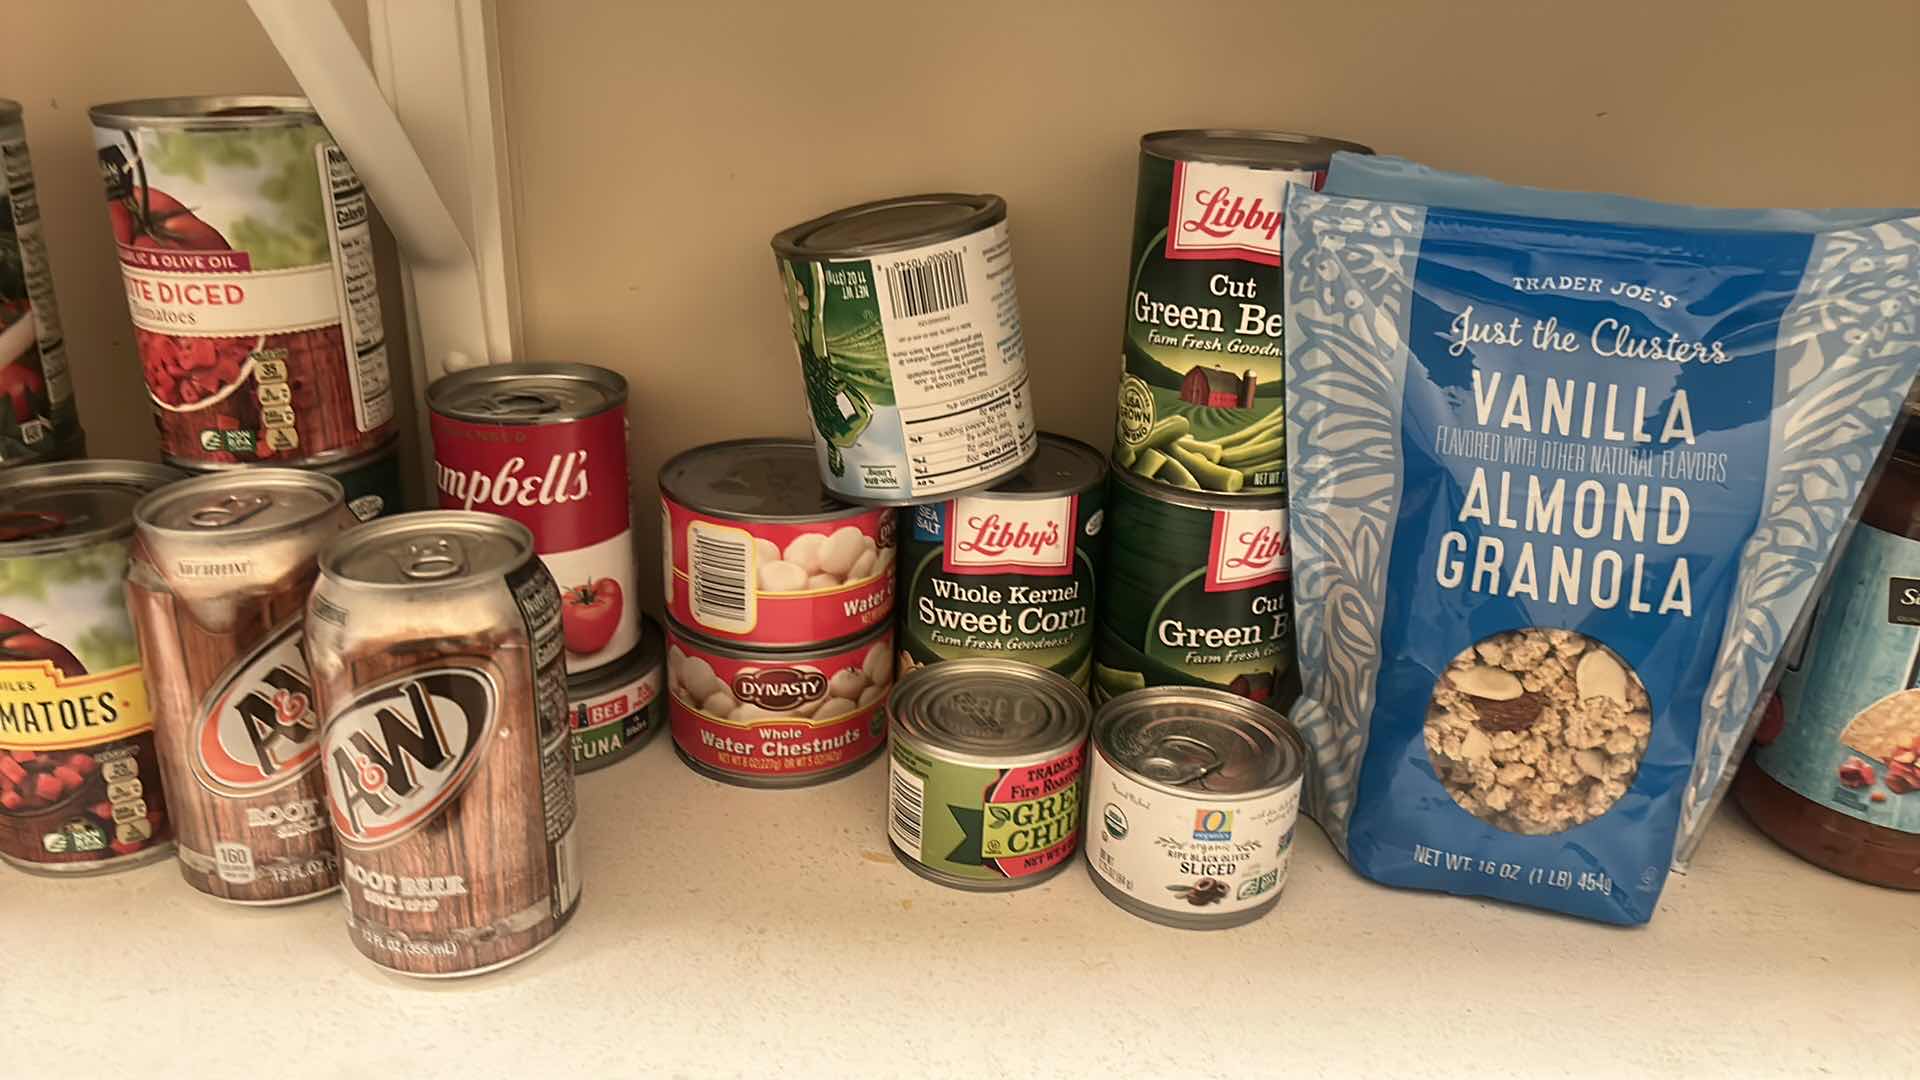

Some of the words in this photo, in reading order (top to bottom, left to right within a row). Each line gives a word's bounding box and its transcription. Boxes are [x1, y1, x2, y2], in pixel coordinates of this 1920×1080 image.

[1183, 186, 1283, 240] Libby
[161, 255, 204, 269] OLIVE
[208, 255, 239, 268] OIL
[158, 282, 245, 305] DICED
[856, 286, 869, 299] NET
[1210, 274, 1256, 299] Cut
[1512, 276, 1602, 293] TRADER
[1610, 281, 1678, 309] JOE'S
[1135, 292, 1224, 332] Green
[1148, 329, 1178, 346] Farm
[1182, 334, 1221, 351] Fresh
[1227, 338, 1284, 357] Goodn
[1449, 305, 1523, 357] Just
[1532, 316, 1580, 353] the
[1591, 317, 1733, 365] Clusters
[1472, 369, 1696, 446] VANILLA
[1435, 424, 1501, 462] FLAVORED
[1504, 434, 1537, 468] WITH
[1541, 440, 1585, 474] OTHER
[1590, 444, 1654, 479] NATURAL
[1660, 450, 1728, 483] FLAVORS
[435, 449, 590, 510] mpbell's
[918, 504, 939, 523] SEA
[1458, 466, 1690, 545] ALMOND
[916, 518, 942, 536] SALT
[959, 514, 1060, 556] Libby's
[1436, 530, 1693, 618] GRANOLA
[843, 590, 885, 616] Water
[931, 578, 1002, 605] Whole
[1008, 581, 1080, 605] Kernel
[1252, 594, 1285, 616] Cut
[919, 597, 1012, 635] Sweet
[1018, 606, 1087, 635] Corn
[931, 630, 961, 646] Farm
[965, 636, 1002, 650] Fresh
[1158, 620, 1264, 649] Green
[1185, 651, 1221, 665] Farm
[1224, 646, 1261, 664] Fresh
[741, 681, 820, 697] DYNASTY
[0, 691, 118, 733] MATOES
[592, 701, 624, 724] BEE
[572, 733, 623, 761] TUNA
[701, 729, 754, 756] Water
[762, 728, 860, 757] Chestnuts
[759, 728, 802, 740] Whole
[332, 680, 456, 838] A&W
[1011, 783, 1040, 799] Fire
[220, 847, 249, 864] 160
[1180, 861, 1236, 876] SLICED
[1190, 854, 1218, 863] BLACK
[1414, 844, 1441, 867] NET
[1445, 851, 1473, 872] WT.
[1478, 860, 1496, 876] 16
[1499, 863, 1522, 881] OZ
[1528, 867, 1543, 886] (1
[1548, 869, 1573, 890] LB)
[1577, 872, 1613, 896] 454g
